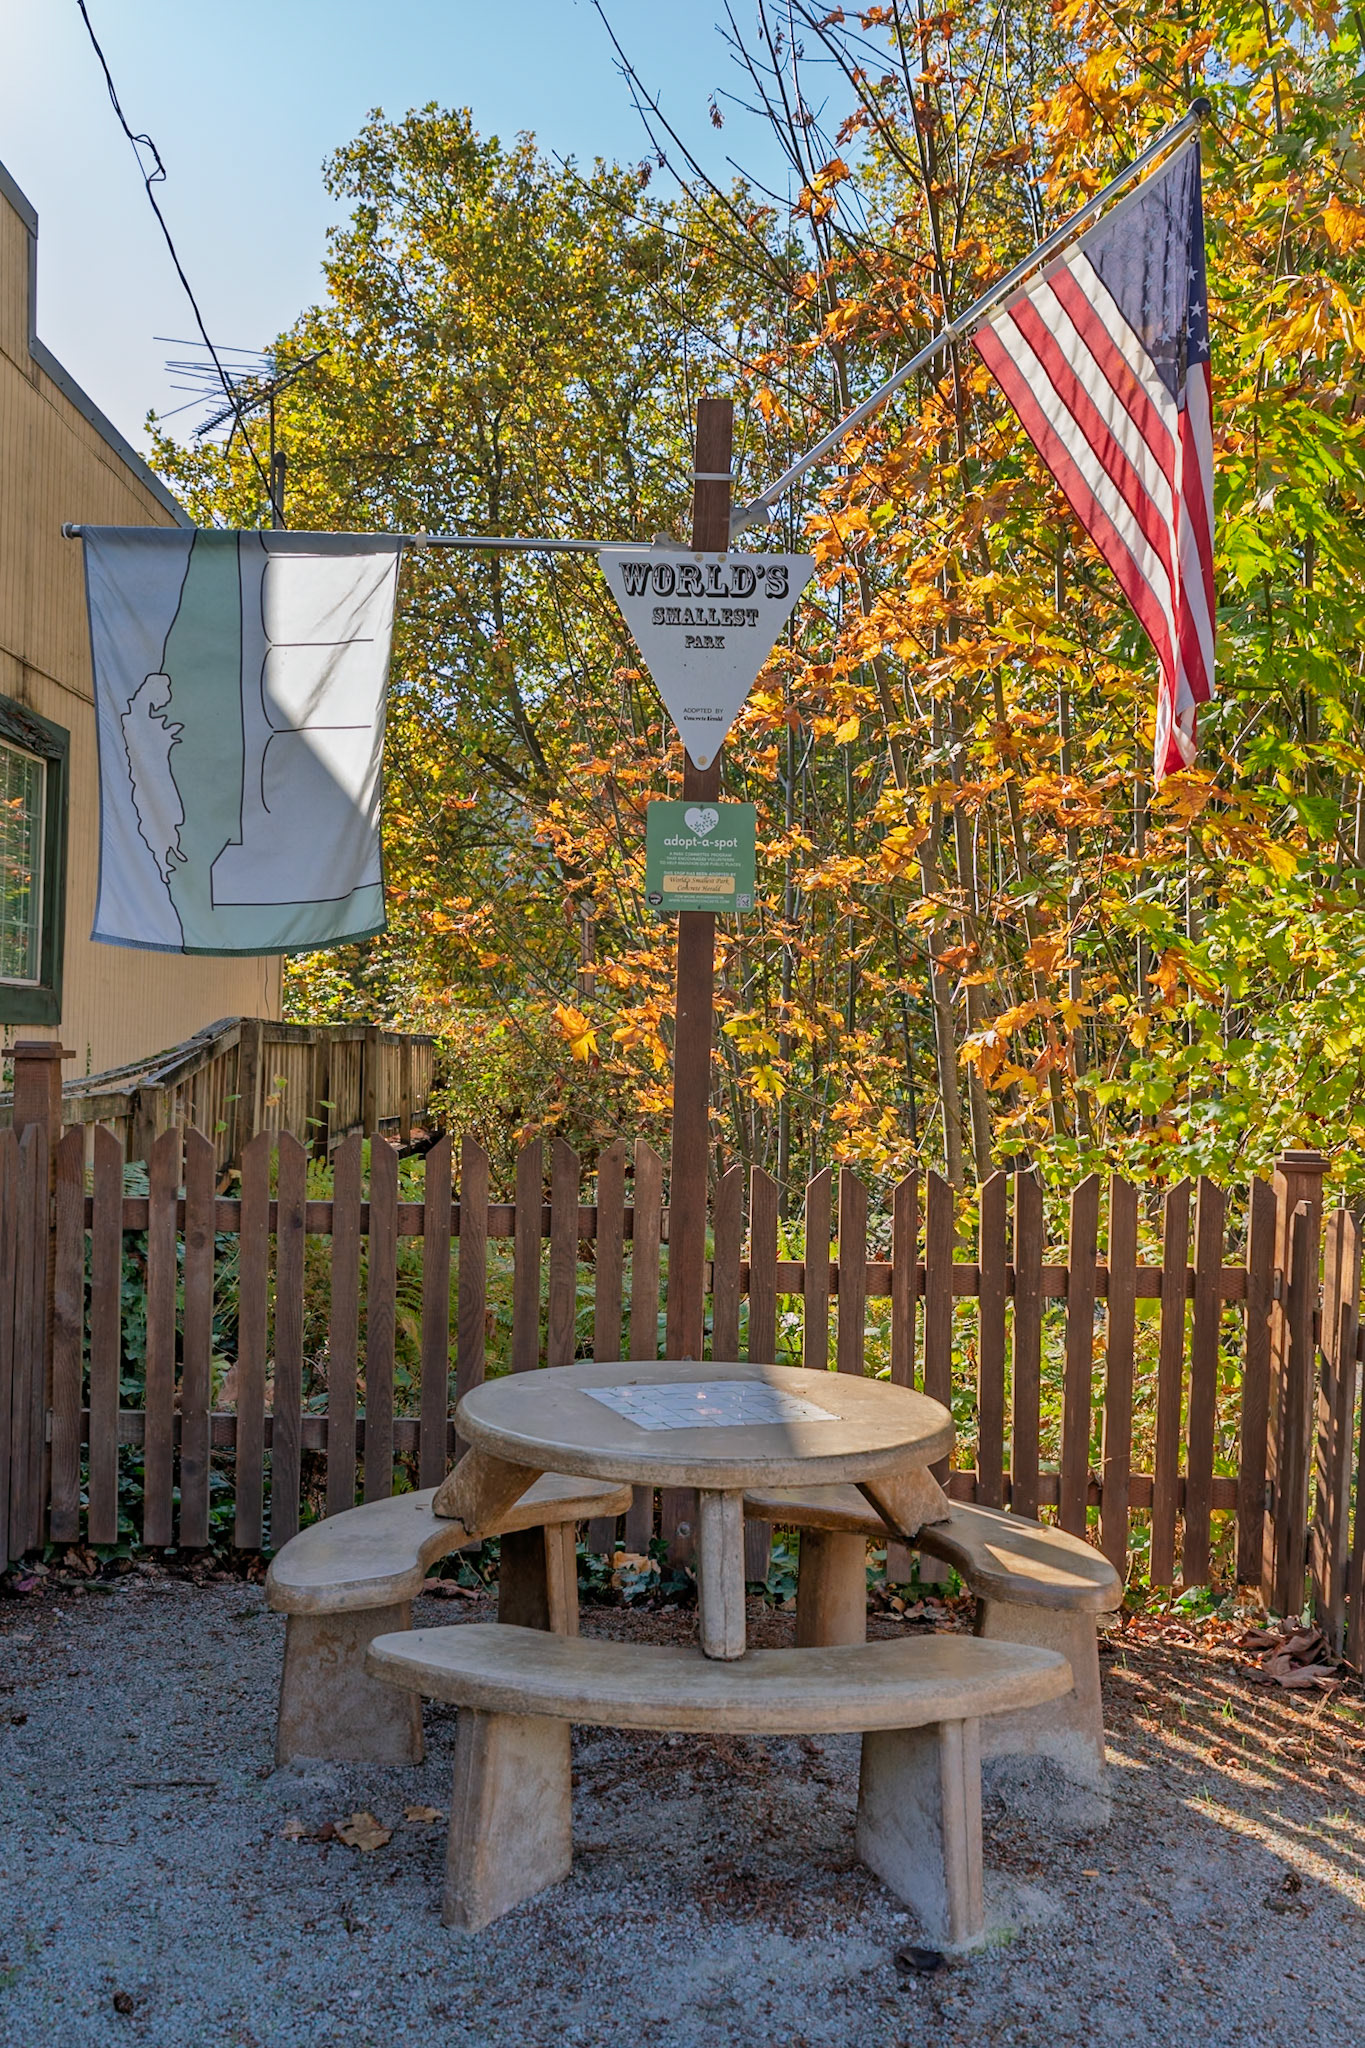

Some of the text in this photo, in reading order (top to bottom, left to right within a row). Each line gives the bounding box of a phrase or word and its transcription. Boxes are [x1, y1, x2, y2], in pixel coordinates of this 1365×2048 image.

[619, 562, 789, 598] WORLD'S
[652, 607, 759, 627] SMALLEST
[684, 635, 725, 649] PARK
[664, 834, 738, 850] adopt-a-spot
